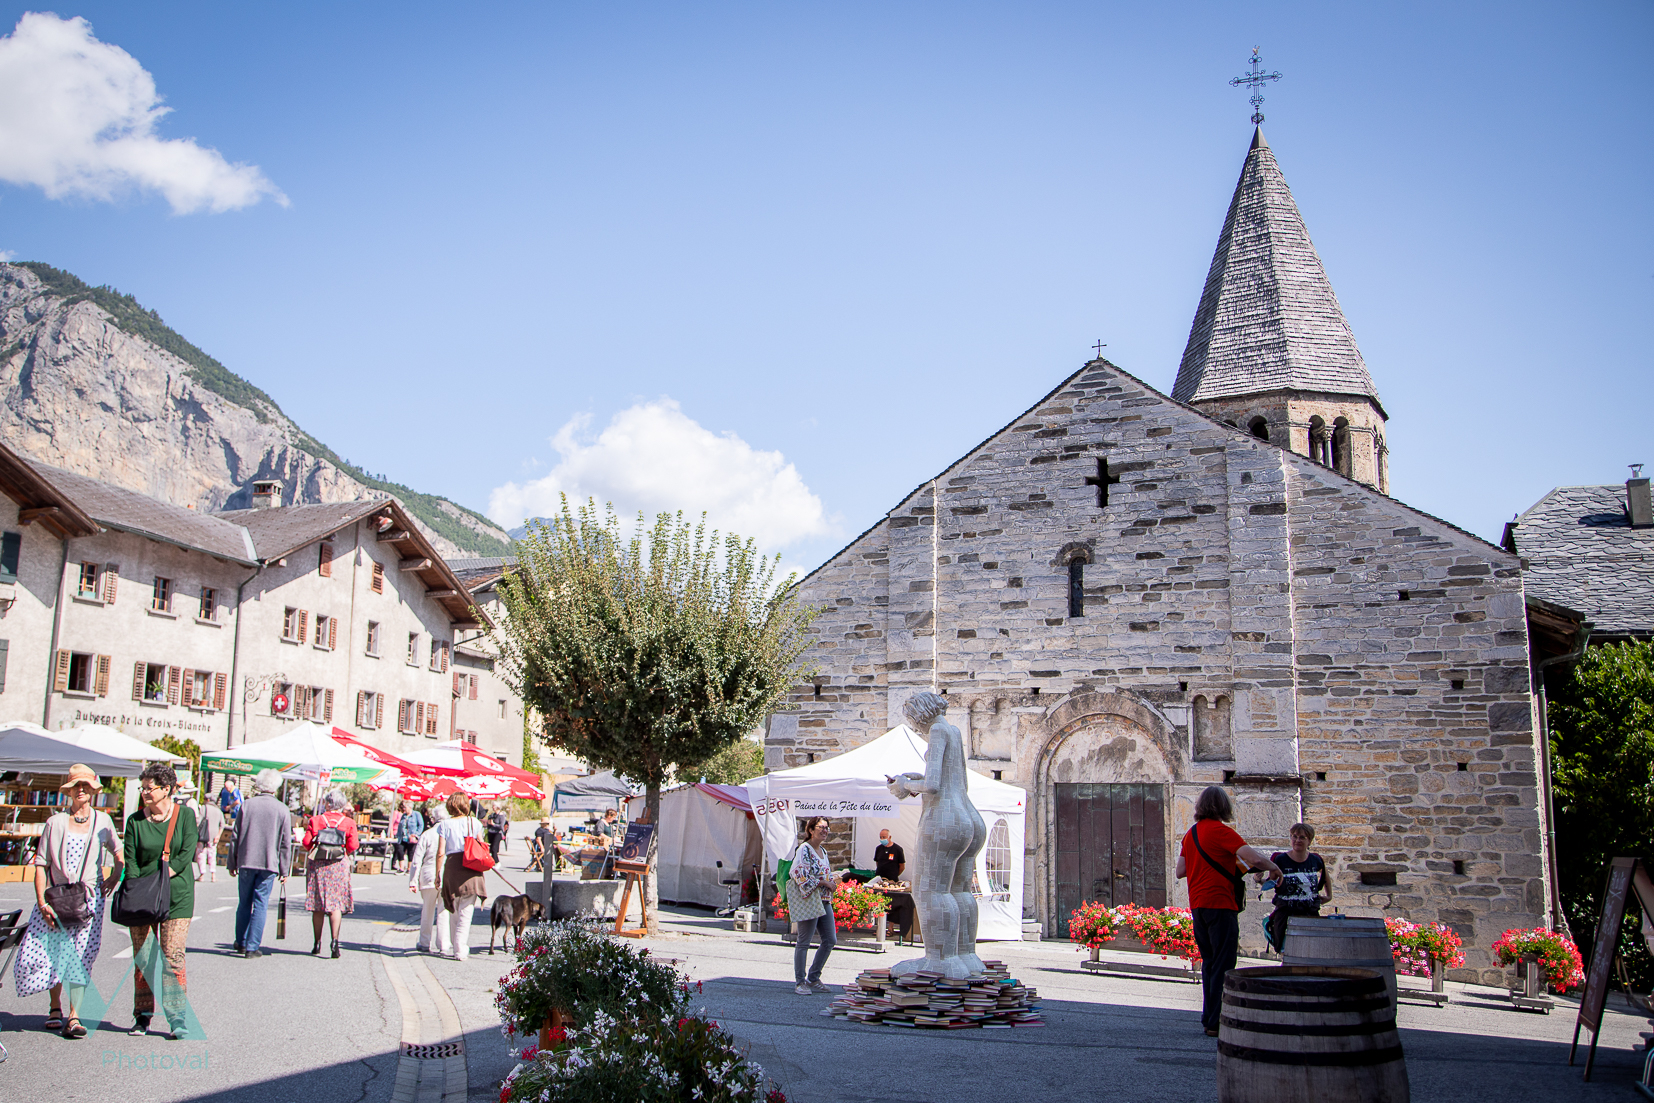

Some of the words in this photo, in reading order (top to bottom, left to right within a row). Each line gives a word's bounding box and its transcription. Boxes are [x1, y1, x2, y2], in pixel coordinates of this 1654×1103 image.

[75, 709, 117, 725] Auberge
[120, 714, 131, 725] de
[134, 716, 143, 726] la
[146, 716, 212, 732] Croix-Blanche
[794, 800, 816, 810] Pains
[817, 801, 827, 810] de
[829, 801, 838, 810] la
[839, 800, 858, 813] Fête
[859, 801, 871, 811] du
[873, 802, 892, 812] livre
